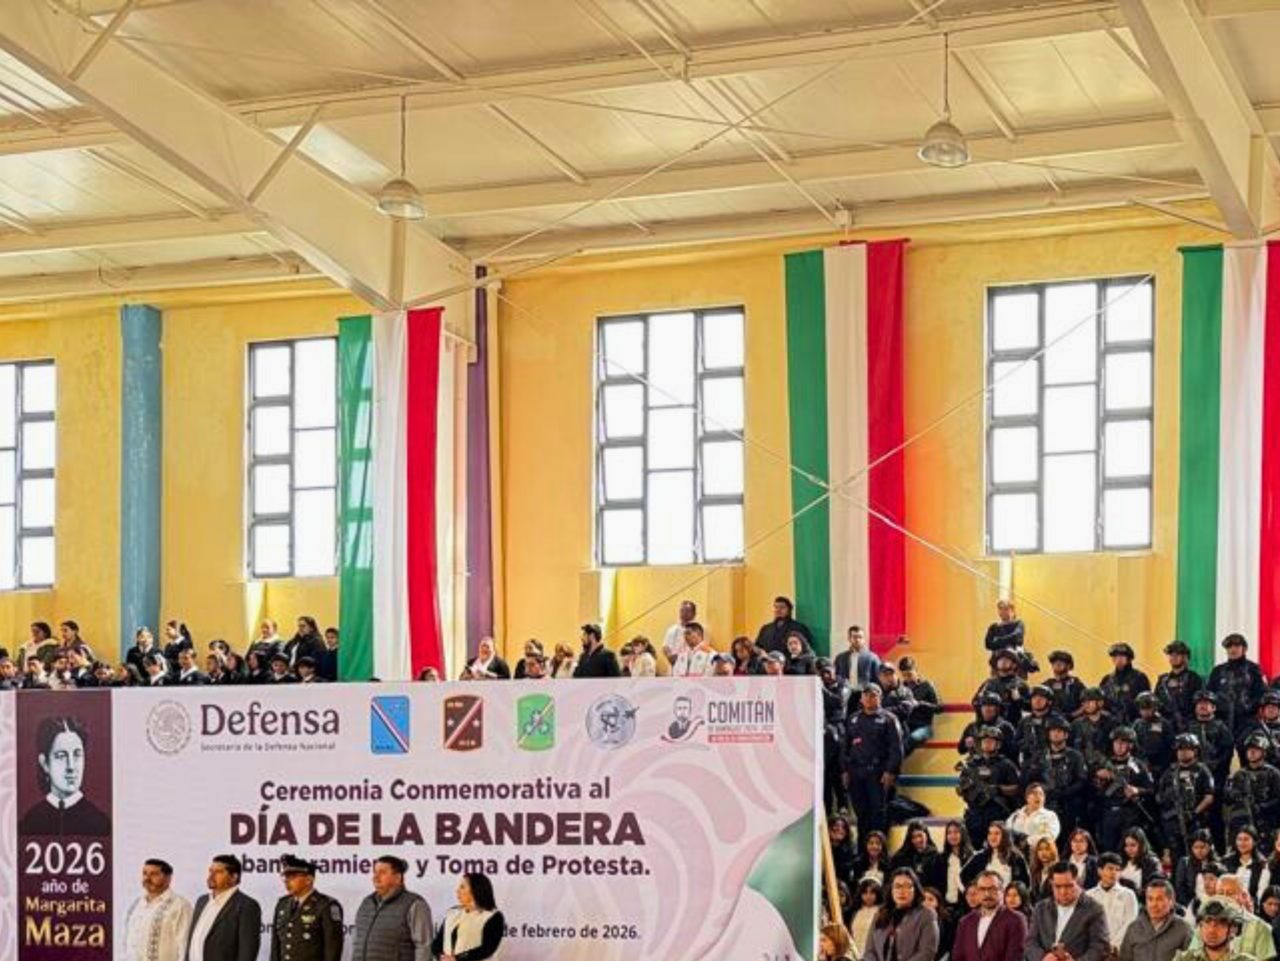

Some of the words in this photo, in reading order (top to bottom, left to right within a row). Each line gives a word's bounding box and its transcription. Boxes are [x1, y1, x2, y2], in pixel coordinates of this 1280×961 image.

[200, 702, 340, 735] Defensa
[708, 696, 775, 723] COMITÁN
[260, 778, 383, 801] Ceremonia
[390, 777, 582, 801] Conmemorativa
[589, 776, 611, 799] al
[230, 804, 298, 846] DÍA
[308, 812, 360, 846] DE
[371, 812, 425, 846] LA
[435, 812, 646, 846] BANDERA
[25, 842, 106, 875] 2026
[416, 859, 429, 878] y
[436, 855, 499, 875] Toma
[506, 855, 535, 875] de
[542, 855, 651, 876] Protesta.
[42, 879, 68, 894] año
[72, 879, 90, 894] de
[26, 896, 106, 917] Margarita
[25, 916, 106, 947] Maza
[521, 922, 577, 938] febrero
[580, 924, 599, 938] de
